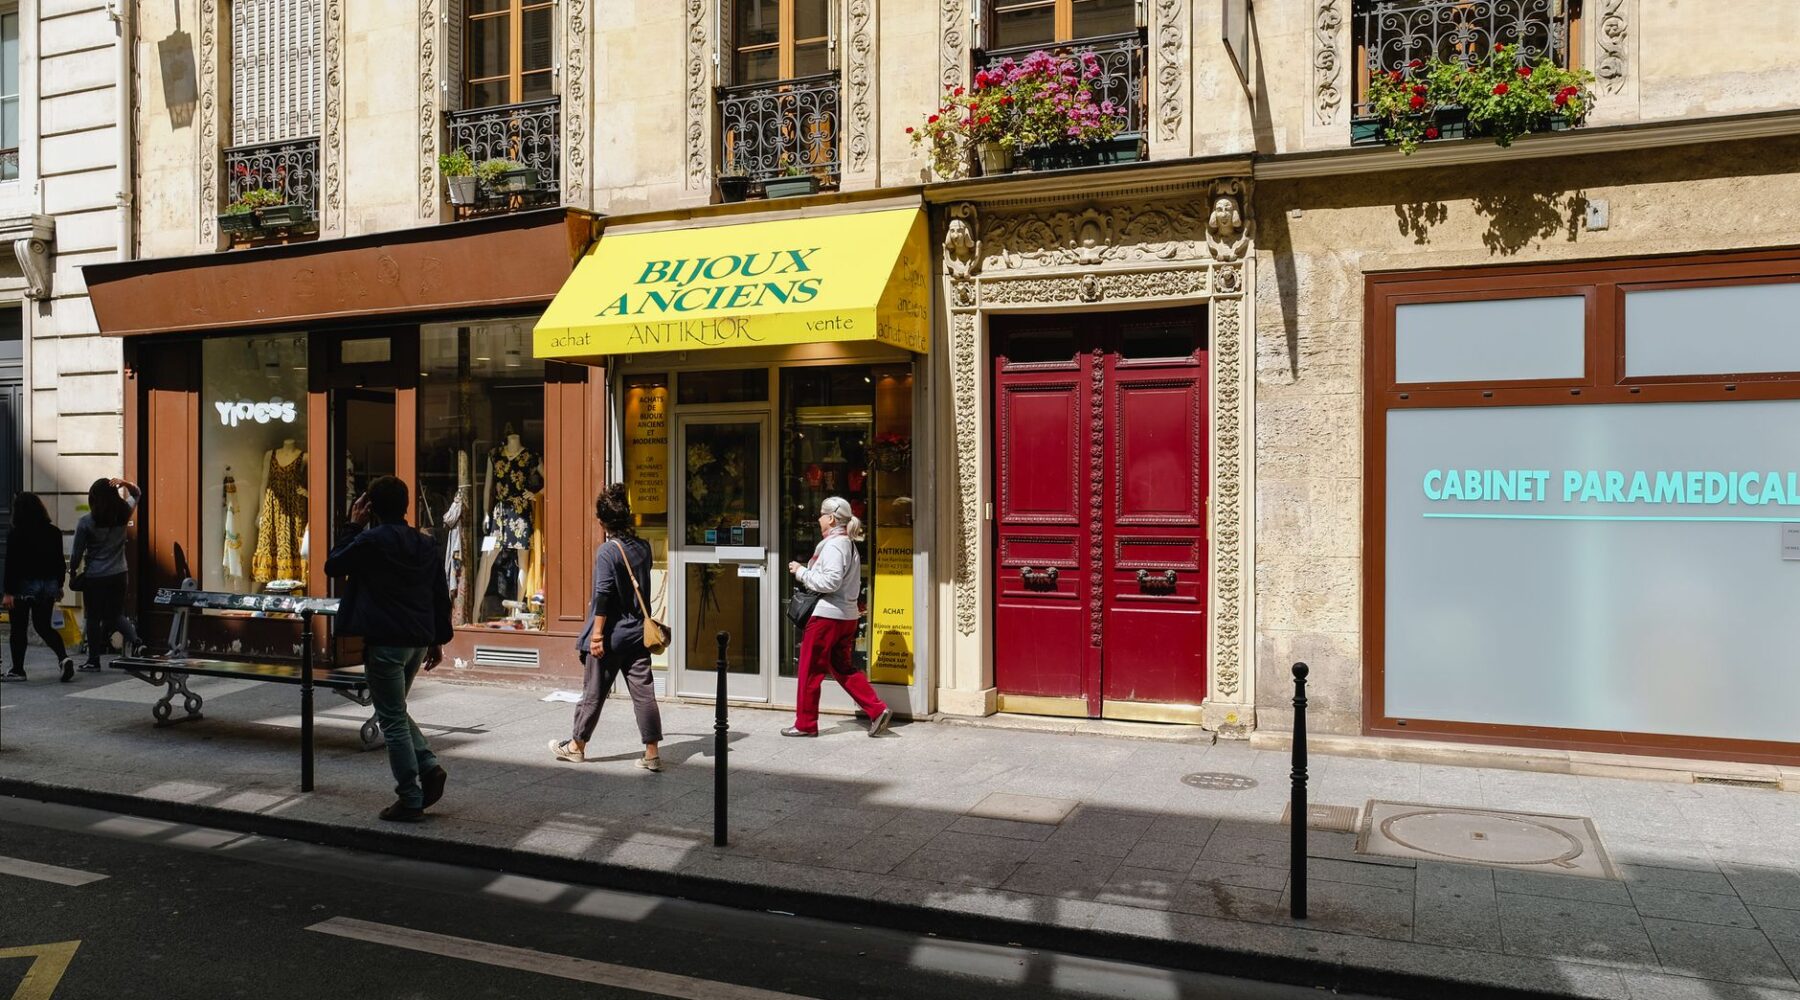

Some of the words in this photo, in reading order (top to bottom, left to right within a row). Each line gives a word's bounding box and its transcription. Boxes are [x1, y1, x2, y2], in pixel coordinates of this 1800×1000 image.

[634, 247, 821, 287] BIJOUX
[595, 278, 823, 317] ANCIENS
[551, 327, 591, 348] achat
[627, 317, 766, 346] ANTIKHOR
[806, 315, 854, 332] vente
[1423, 469, 1550, 501] CABINET
[1563, 470, 1800, 506] PARAMEDICAL
[873, 622, 891, 630] Bijoux
[882, 607, 905, 615] ACHAT
